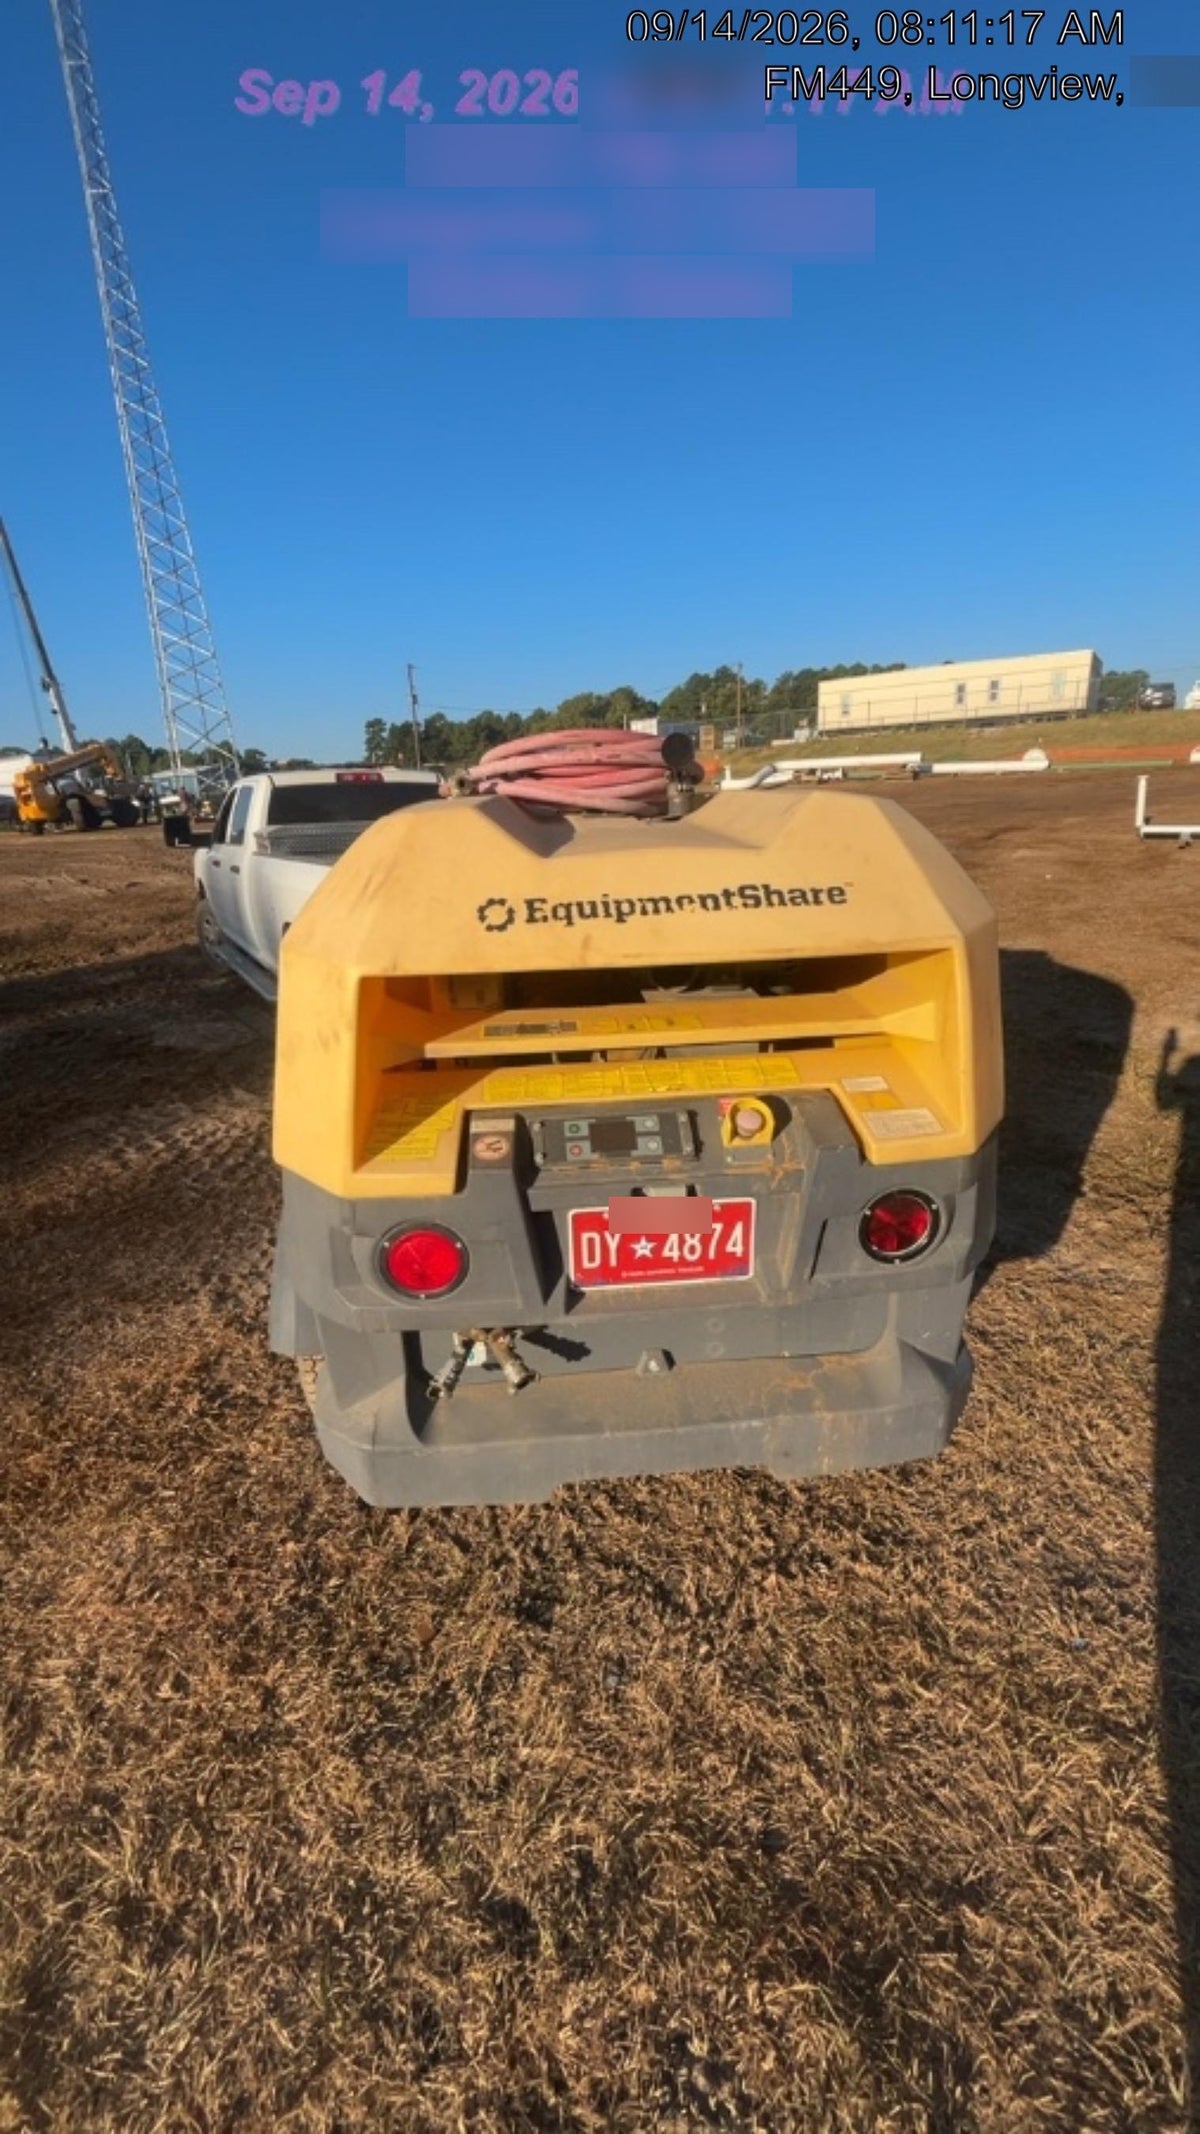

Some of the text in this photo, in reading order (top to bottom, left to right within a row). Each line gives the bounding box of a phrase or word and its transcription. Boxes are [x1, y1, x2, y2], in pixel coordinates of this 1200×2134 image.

[524, 884, 849, 926] EquipmentShare
[580, 1221, 744, 1269] DY 4874
